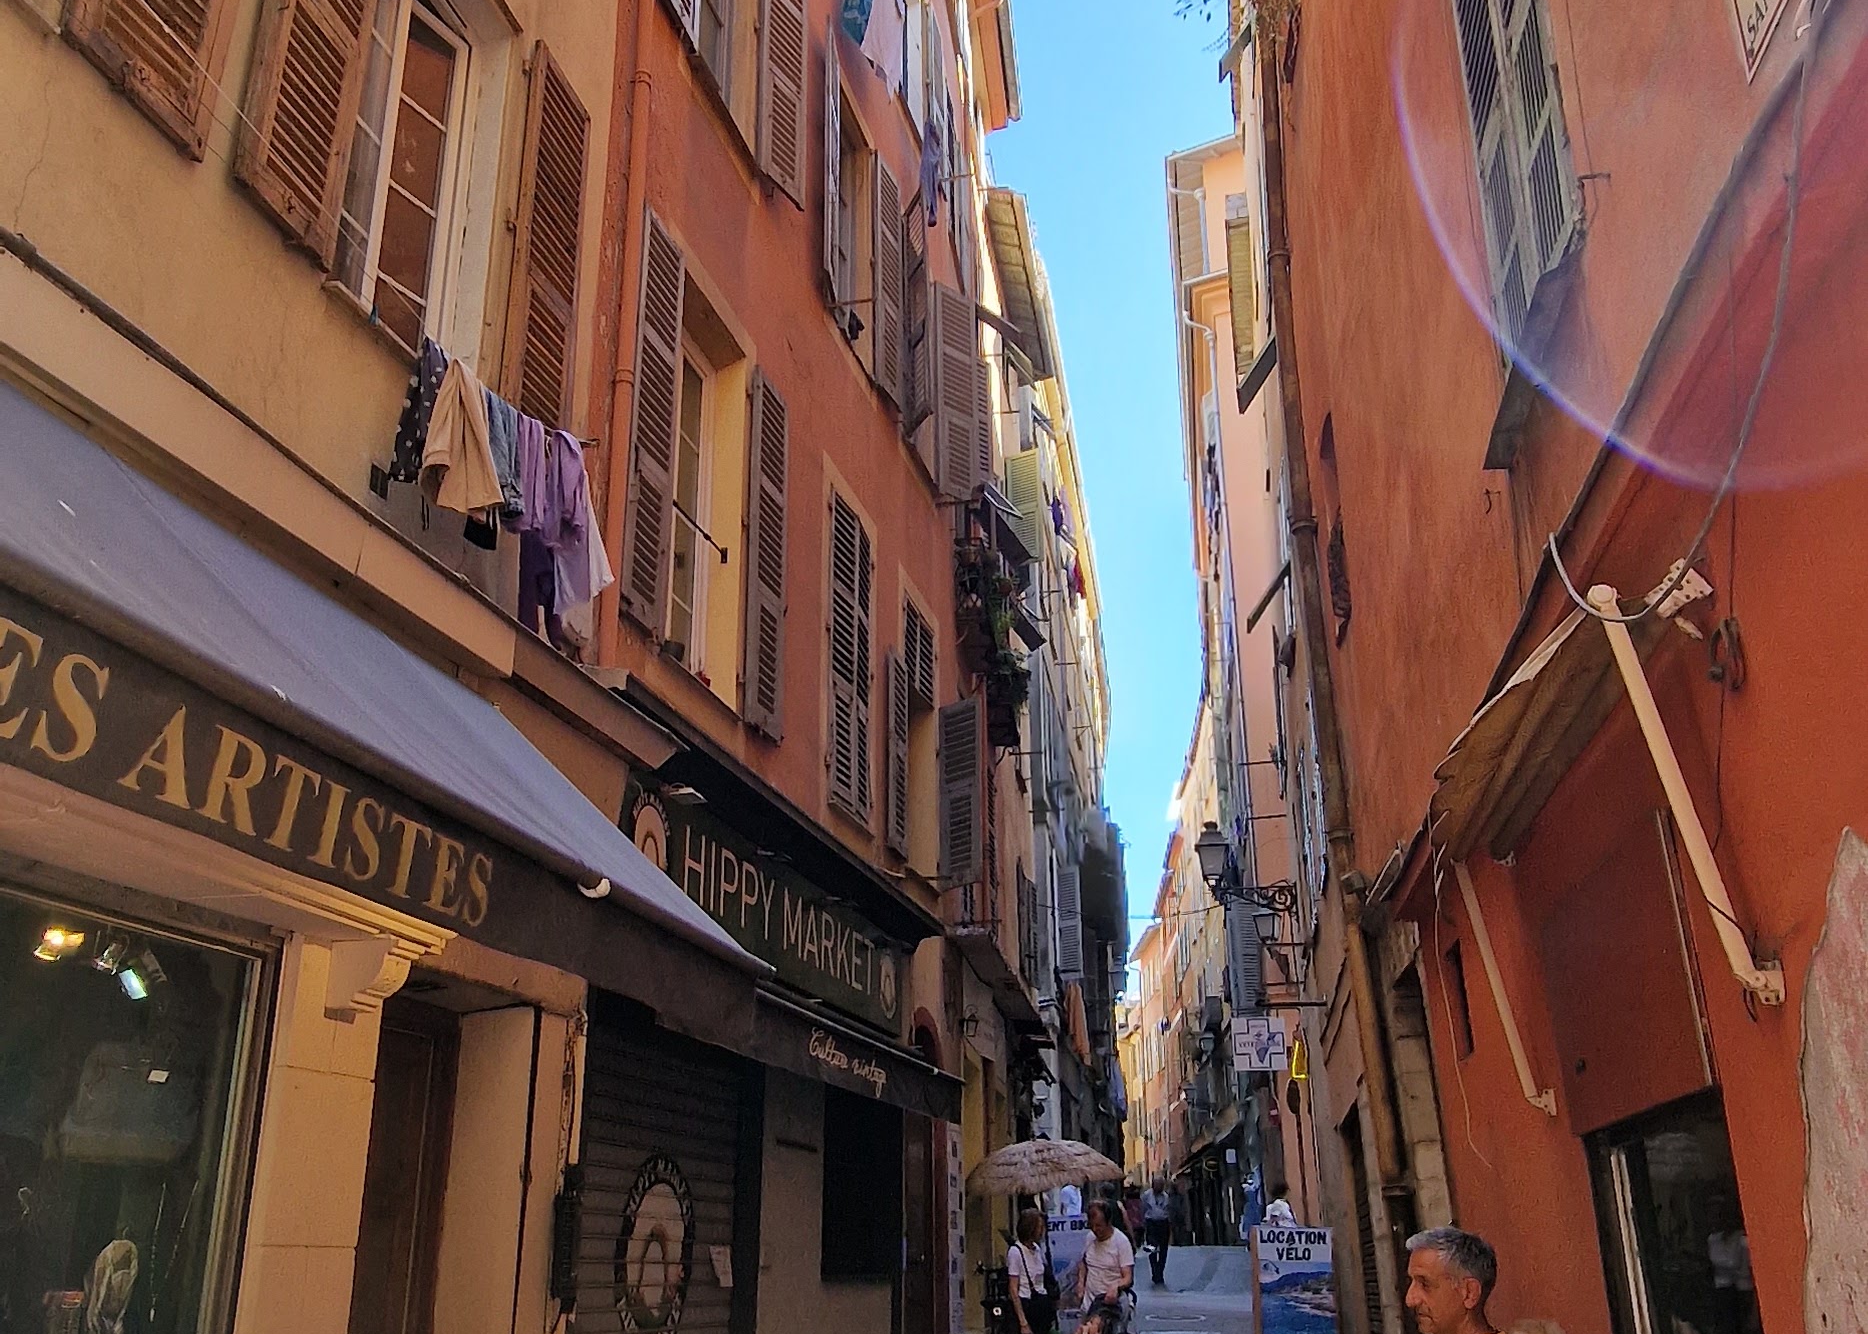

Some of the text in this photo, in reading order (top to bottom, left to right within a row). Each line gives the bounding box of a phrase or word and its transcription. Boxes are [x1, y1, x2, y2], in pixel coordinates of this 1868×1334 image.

[117, 704, 494, 928] ARTISTES
[684, 825, 875, 996] HIPPY MARKET
[1259, 1229, 1327, 1245] LOCATION
